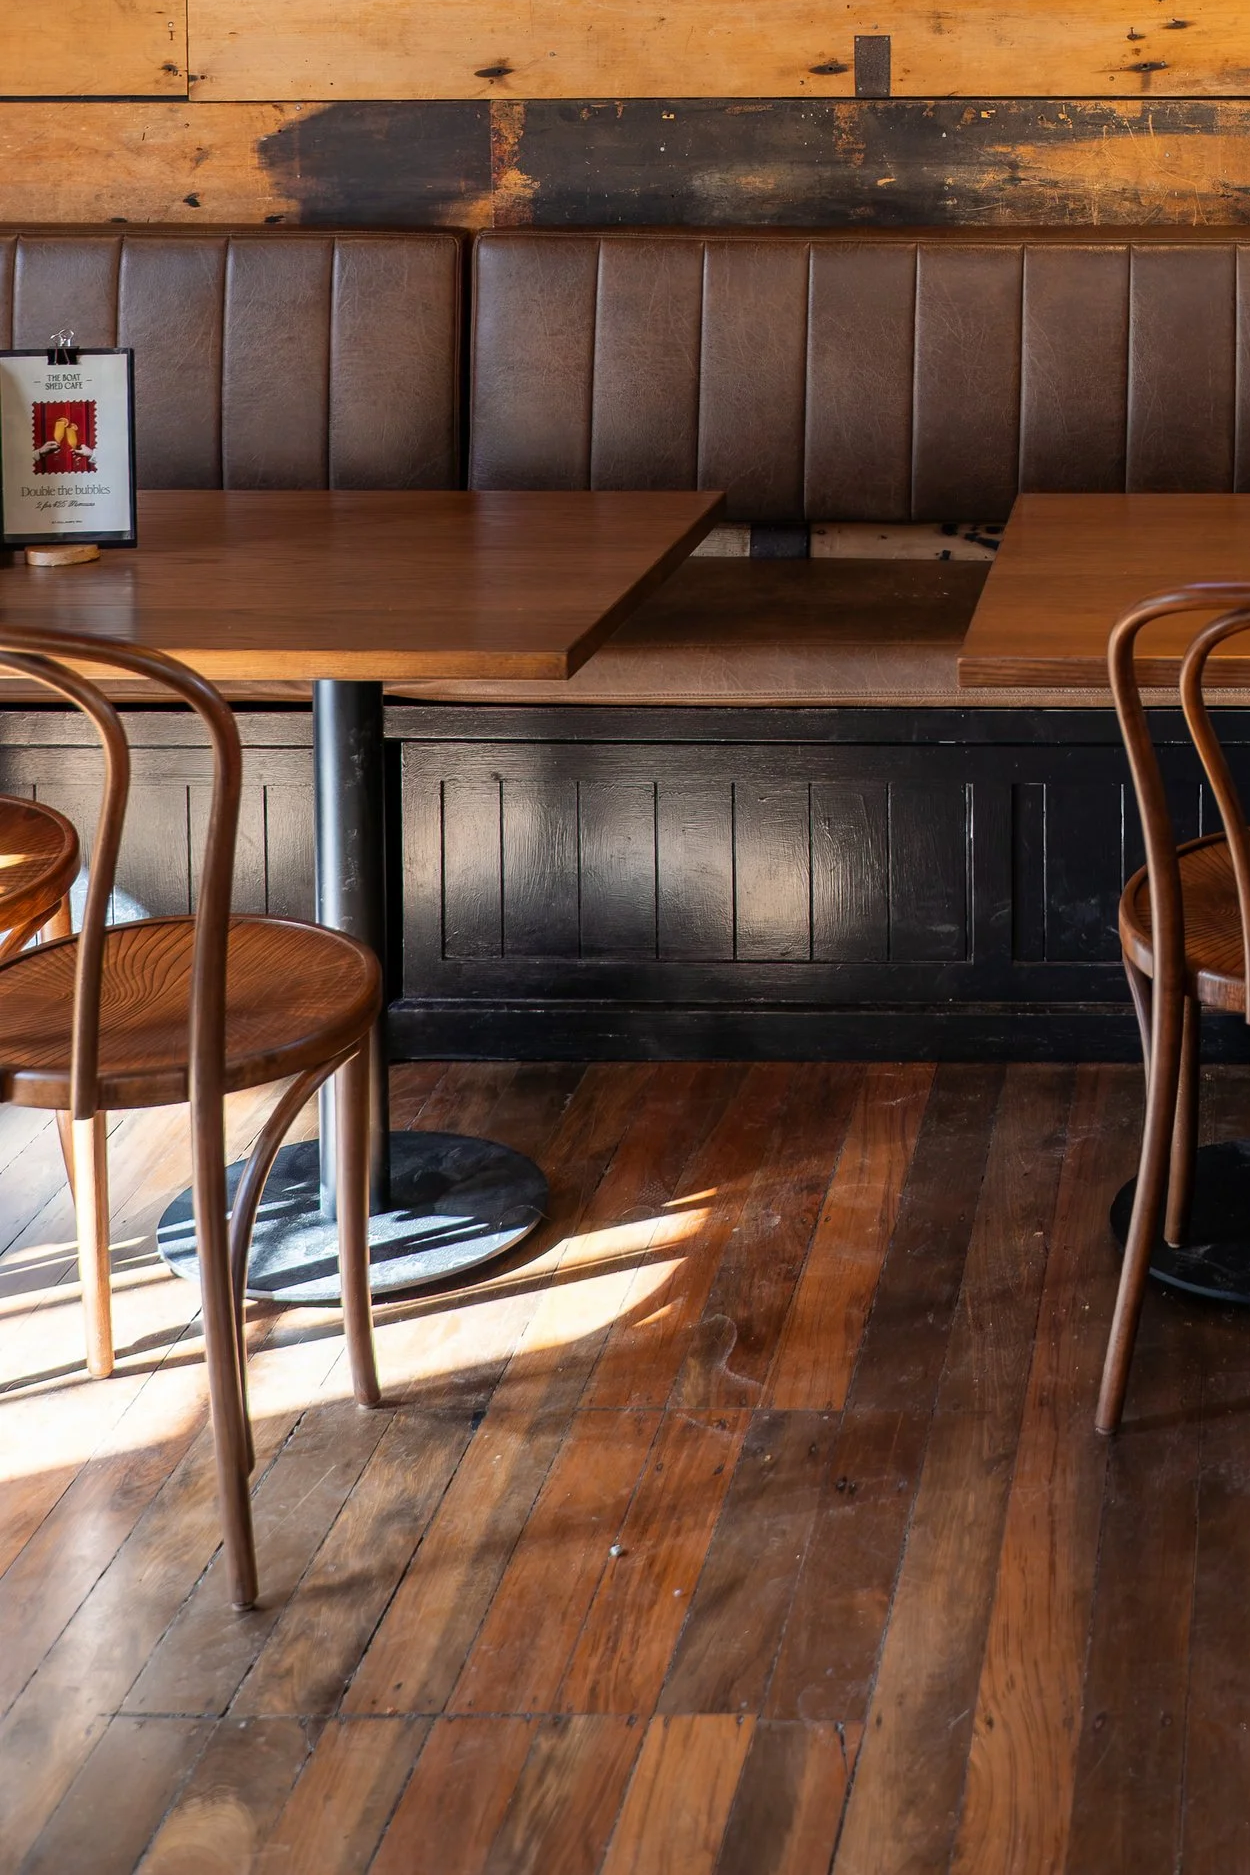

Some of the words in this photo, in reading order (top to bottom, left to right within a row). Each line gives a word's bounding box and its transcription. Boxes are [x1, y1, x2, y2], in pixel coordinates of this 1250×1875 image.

[46, 374, 61, 382] THE
[62, 373, 81, 382] BOAT
[45, 382, 63, 390] SHED
[21, 486, 56, 497] Double
[57, 485, 74, 496] the
[75, 484, 111, 495] bubbles
